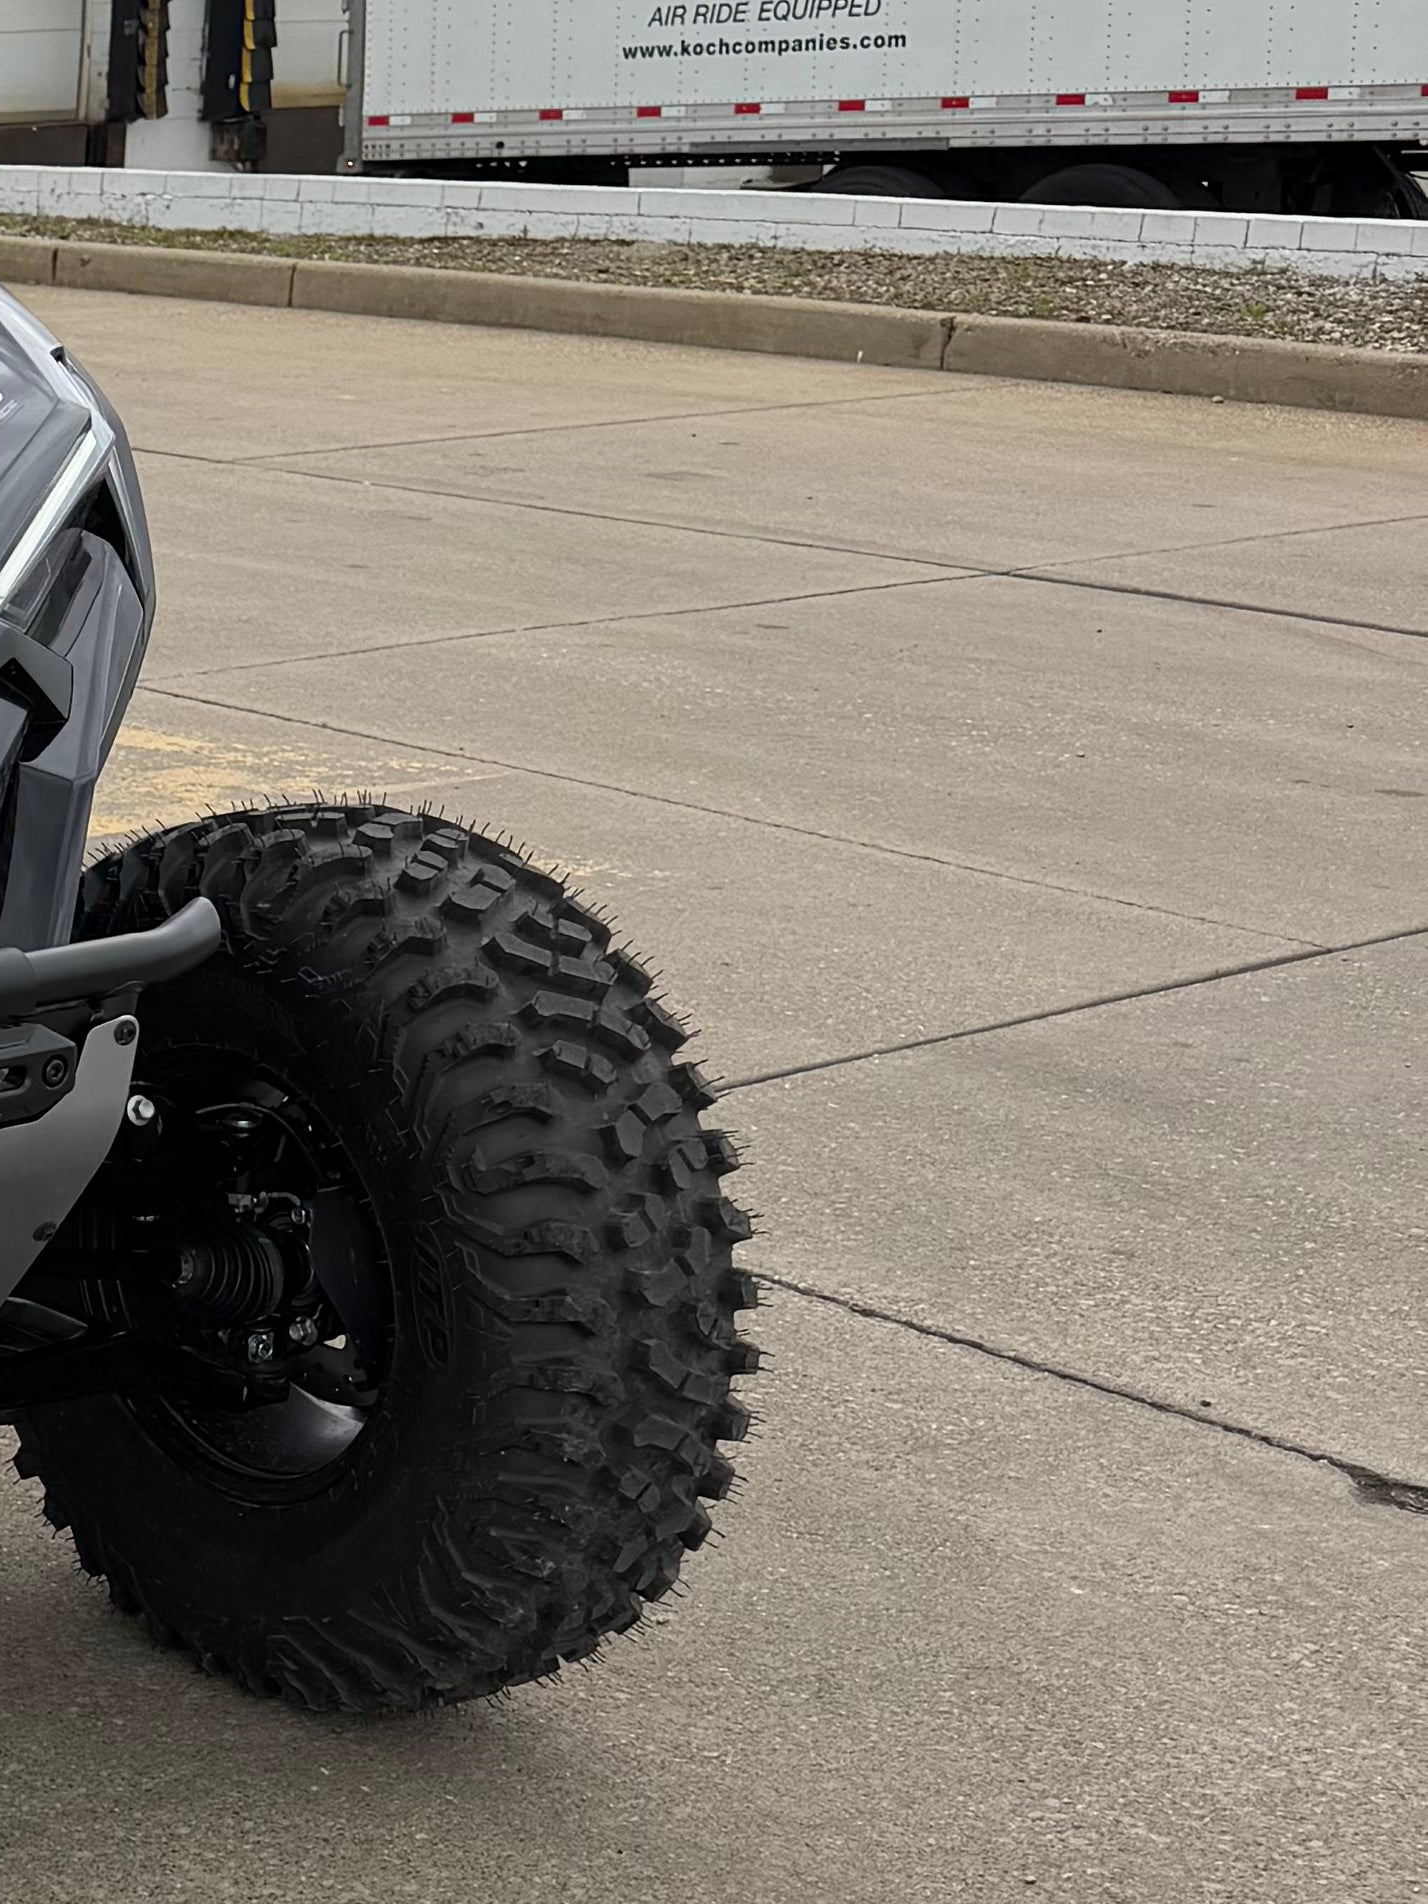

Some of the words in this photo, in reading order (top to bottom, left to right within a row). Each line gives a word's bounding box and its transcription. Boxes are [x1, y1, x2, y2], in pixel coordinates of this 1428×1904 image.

[648, 4, 687, 27] AIR
[693, 1, 749, 25] RIDE
[622, 33, 907, 59] www.kochcompanies.com
